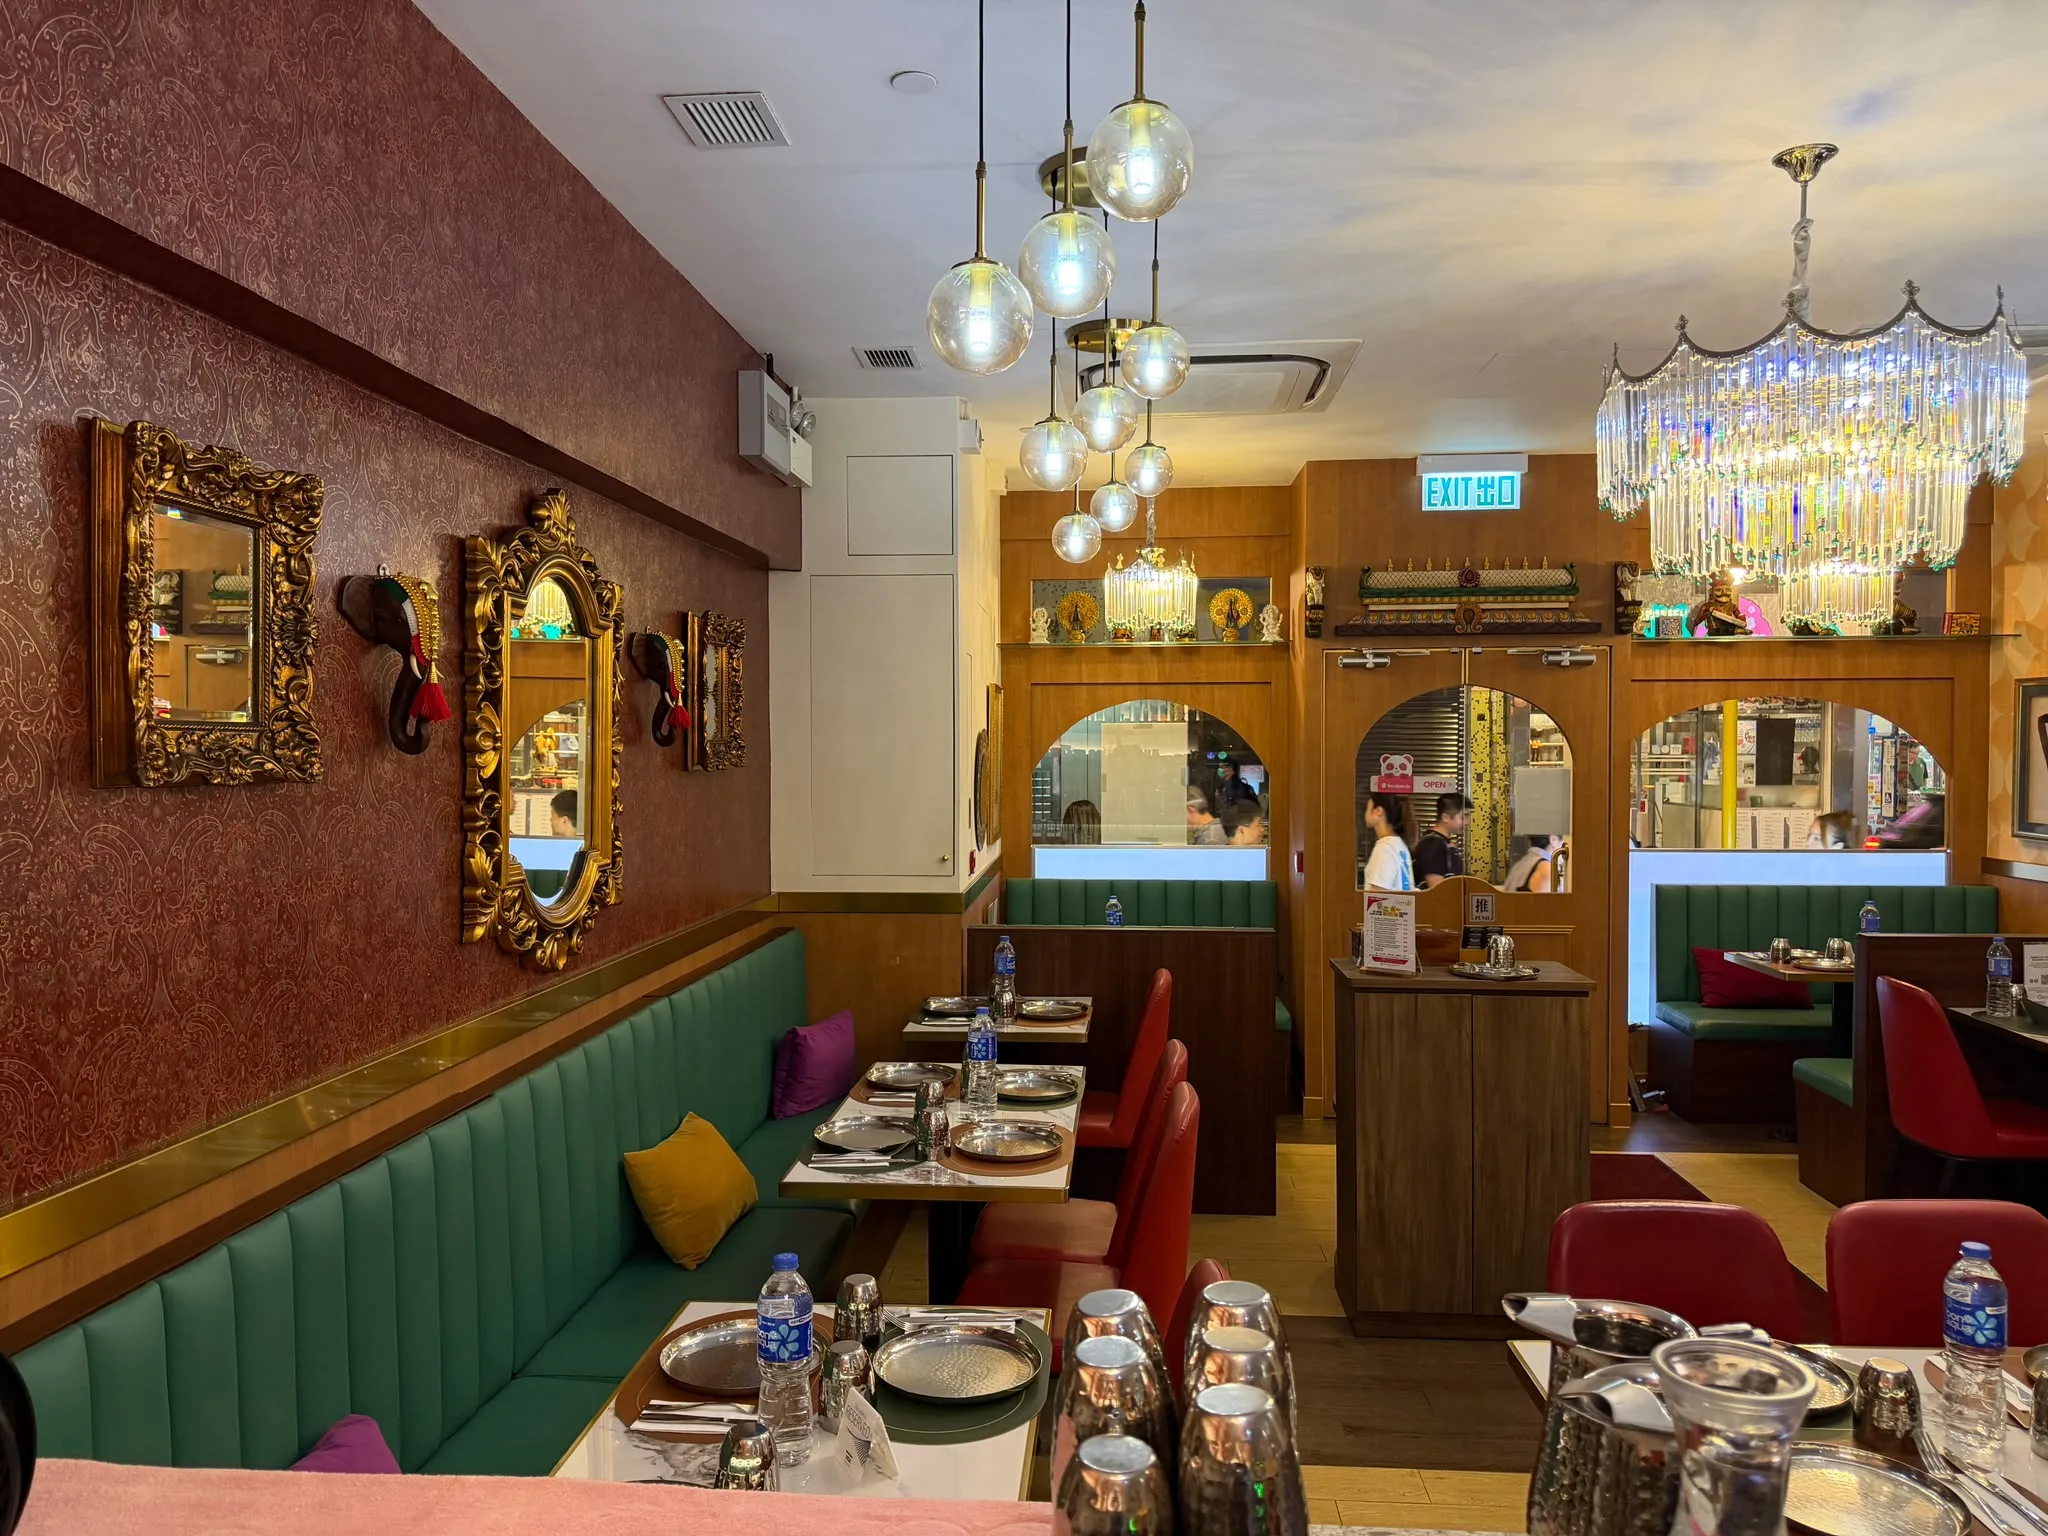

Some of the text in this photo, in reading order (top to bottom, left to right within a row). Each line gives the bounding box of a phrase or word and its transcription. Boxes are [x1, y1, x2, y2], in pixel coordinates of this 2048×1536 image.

[1427, 475, 1515, 507] EXIT 出口
[1475, 898, 1489, 913] 推
[845, 1404, 871, 1439] RESERVED
